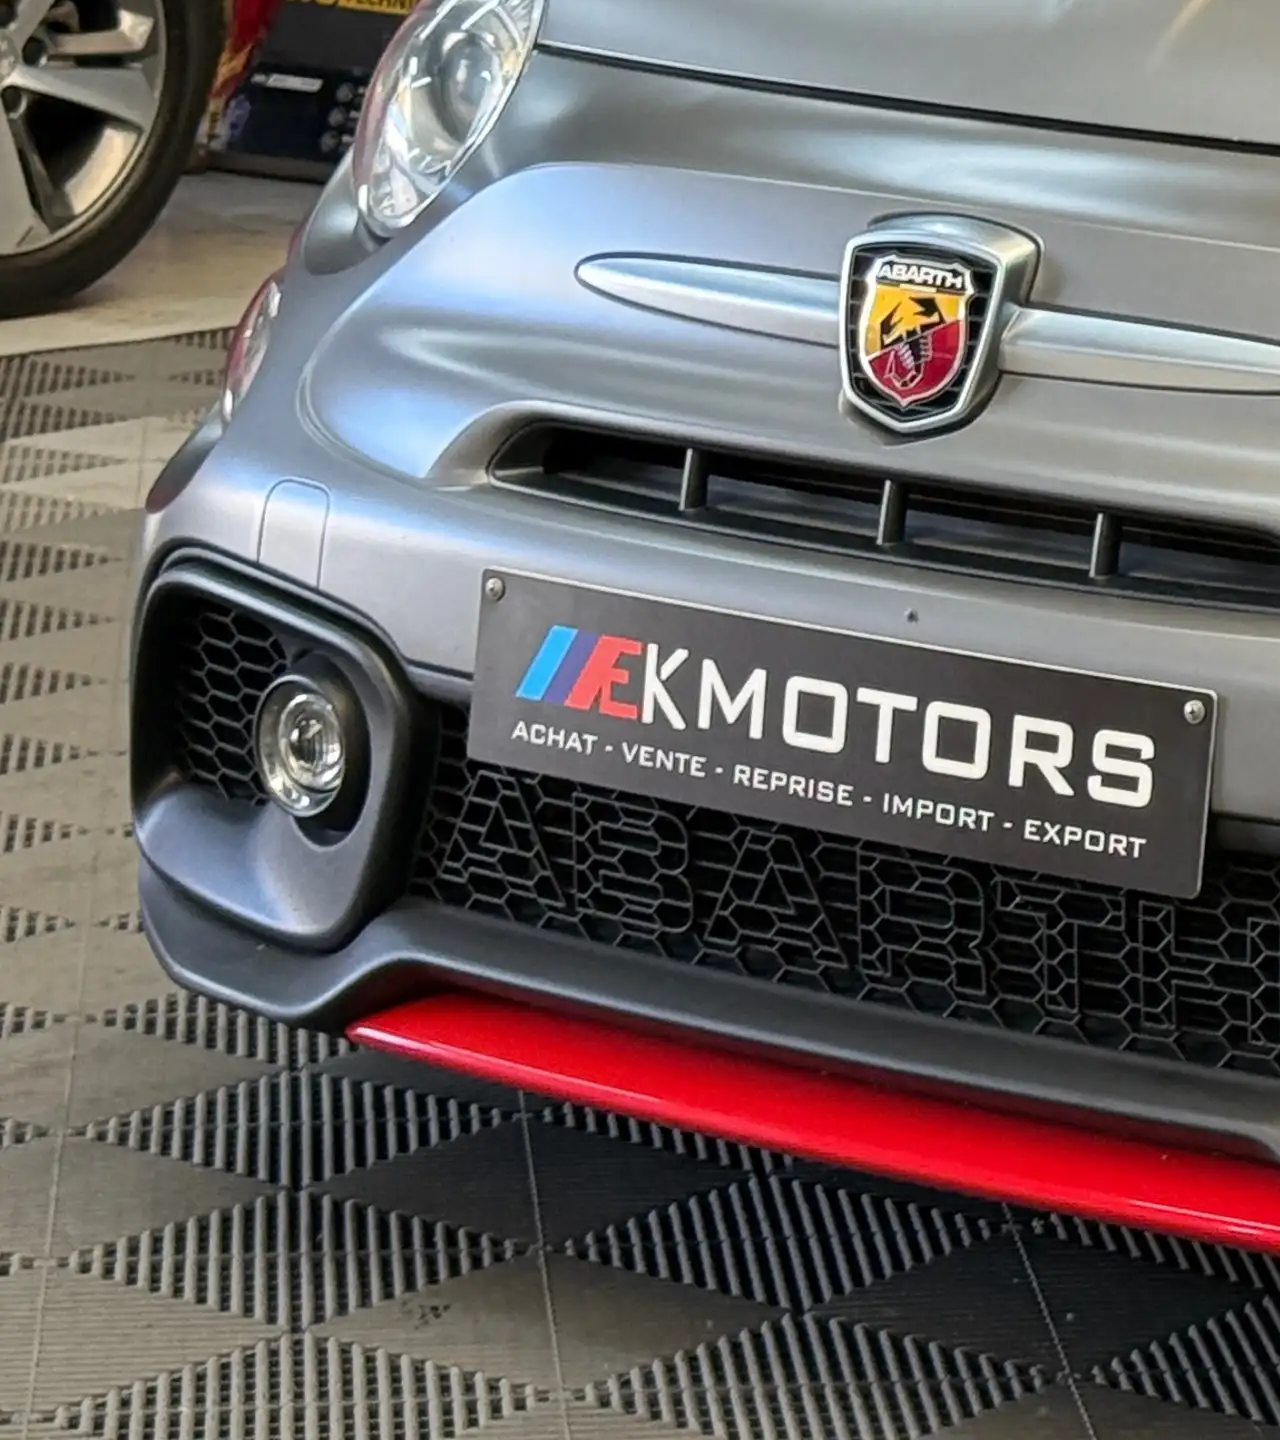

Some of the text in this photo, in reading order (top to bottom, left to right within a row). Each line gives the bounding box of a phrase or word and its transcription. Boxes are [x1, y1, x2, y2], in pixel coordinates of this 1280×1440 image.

[878, 263, 963, 289] ABARTH
[510, 720, 599, 756] ACHAT
[621, 742, 708, 778] VENTE
[732, 763, 854, 807] REPRISE
[882, 792, 995, 832] IMPORT
[1023, 818, 1147, 859] EXPORT
